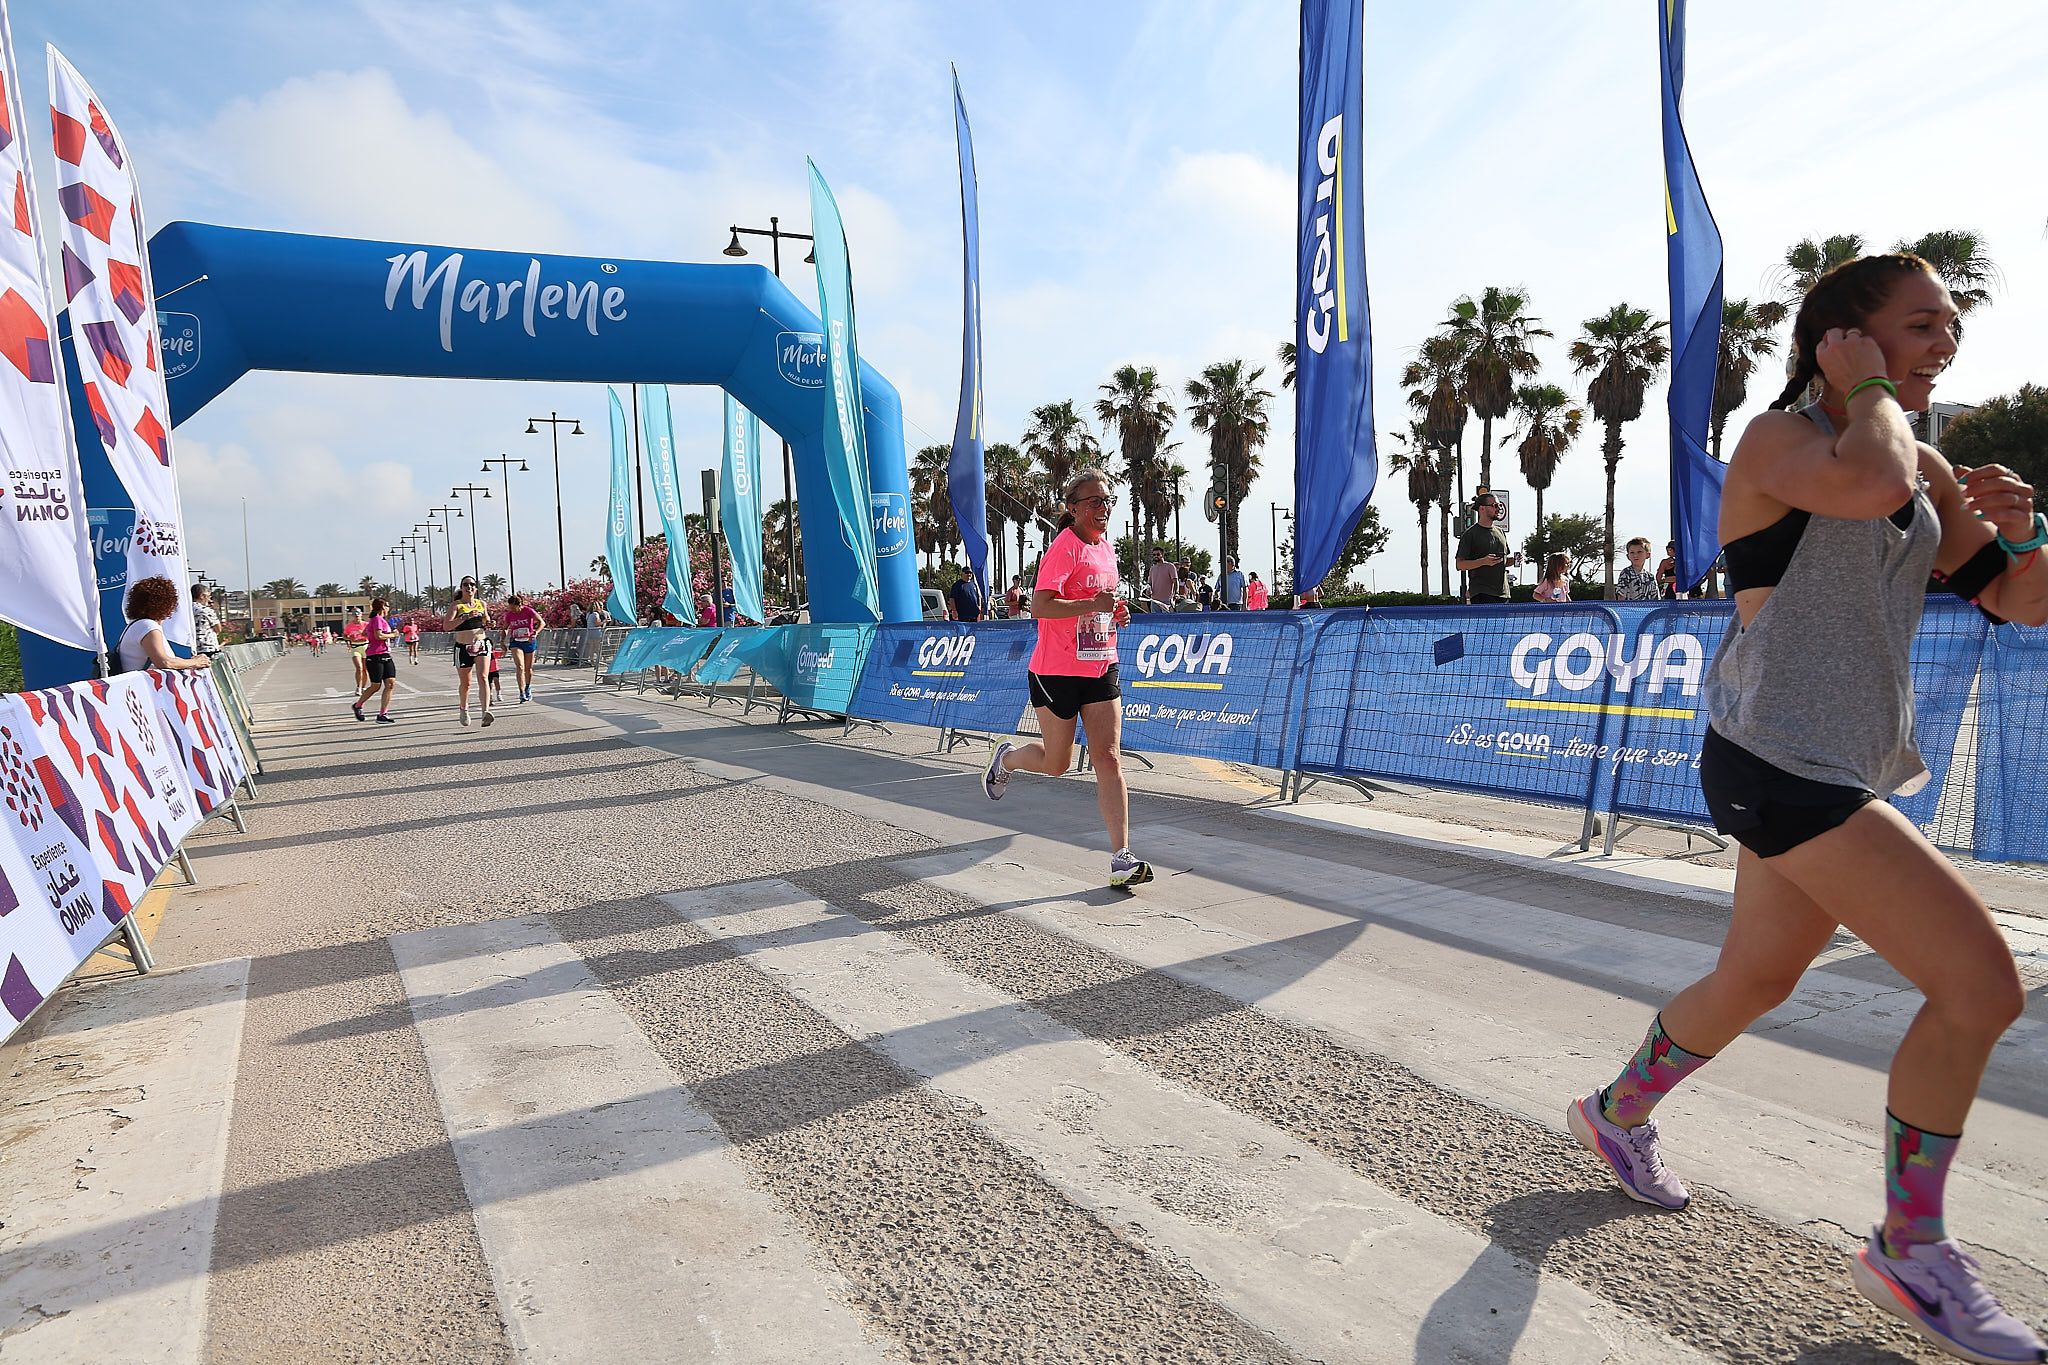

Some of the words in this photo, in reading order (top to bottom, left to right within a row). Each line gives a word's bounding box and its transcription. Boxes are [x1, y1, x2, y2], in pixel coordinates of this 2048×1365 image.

[385, 250, 628, 352] Marlene
[797, 644, 835, 674] Compeed
[918, 635, 976, 669] GOYA
[1136, 633, 1233, 678] GOYA
[1510, 632, 1704, 697] GOYA
[903, 687, 921, 698] GOYA
[1125, 703, 1151, 717] GOYA
[1175, 709, 1197, 730] que
[1197, 709, 1216, 721] ser
[1216, 702, 1259, 725] bueno!
[1474, 733, 1495, 748] es
[1497, 731, 1550, 752] GOYA
[1611, 746, 1649, 776] que
[1651, 749, 1688, 768] ser
[30, 841, 68, 871] Experience
[59, 891, 95, 936] OMAN
